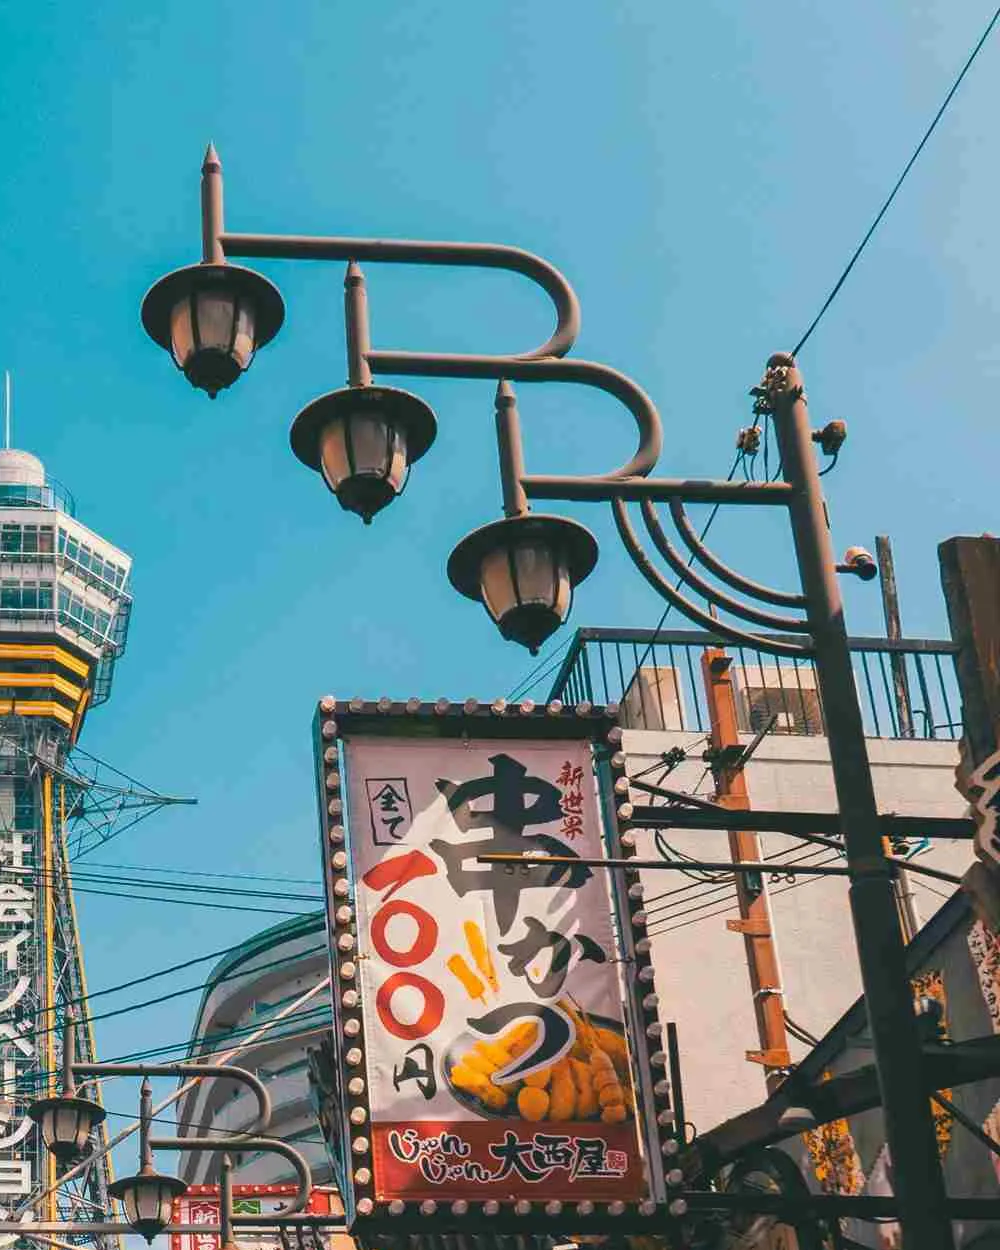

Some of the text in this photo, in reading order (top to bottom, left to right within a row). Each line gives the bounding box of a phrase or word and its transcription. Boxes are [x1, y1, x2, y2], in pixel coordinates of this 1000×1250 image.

[370, 783, 407, 845] 全て
[556, 759, 584, 840] 新世界
[429, 753, 608, 1087] 串かつ
[489, 1130, 624, 1184] 大西屋
